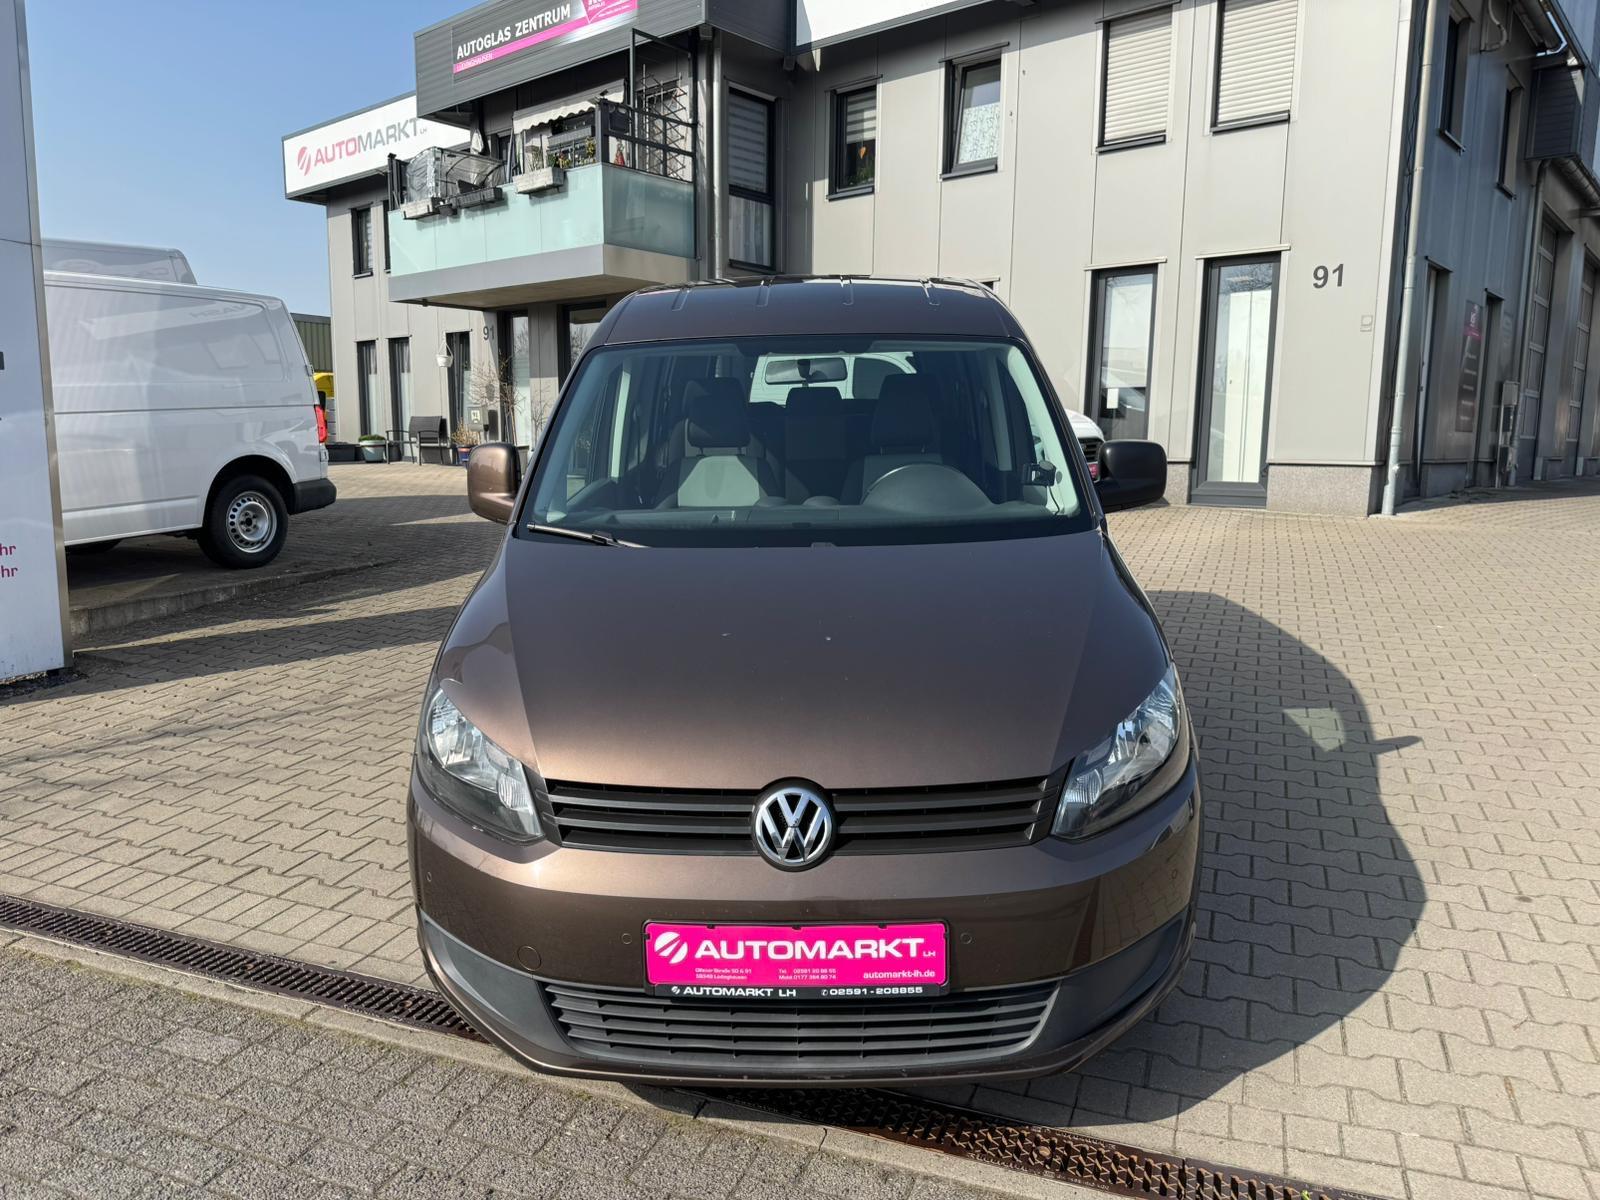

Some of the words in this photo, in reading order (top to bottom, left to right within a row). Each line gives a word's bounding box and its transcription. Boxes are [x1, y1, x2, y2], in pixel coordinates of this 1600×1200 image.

[456, 26, 512, 60] AUTOGLAS
[514, 3, 571, 37] ZENTRUM
[314, 118, 422, 167] AUTOMARKT
[1312, 263, 1345, 289] 91
[483, 324, 495, 341] 91
[0, 543, 17, 556] hr
[0, 565, 18, 578] hr
[694, 938, 925, 960] AUTOMARKT
[863, 969, 936, 979] automarkt-lh.de
[683, 986, 774, 997] AUTOMARKT
[778, 988, 797, 997] LH
[829, 987, 868, 996] 02591
